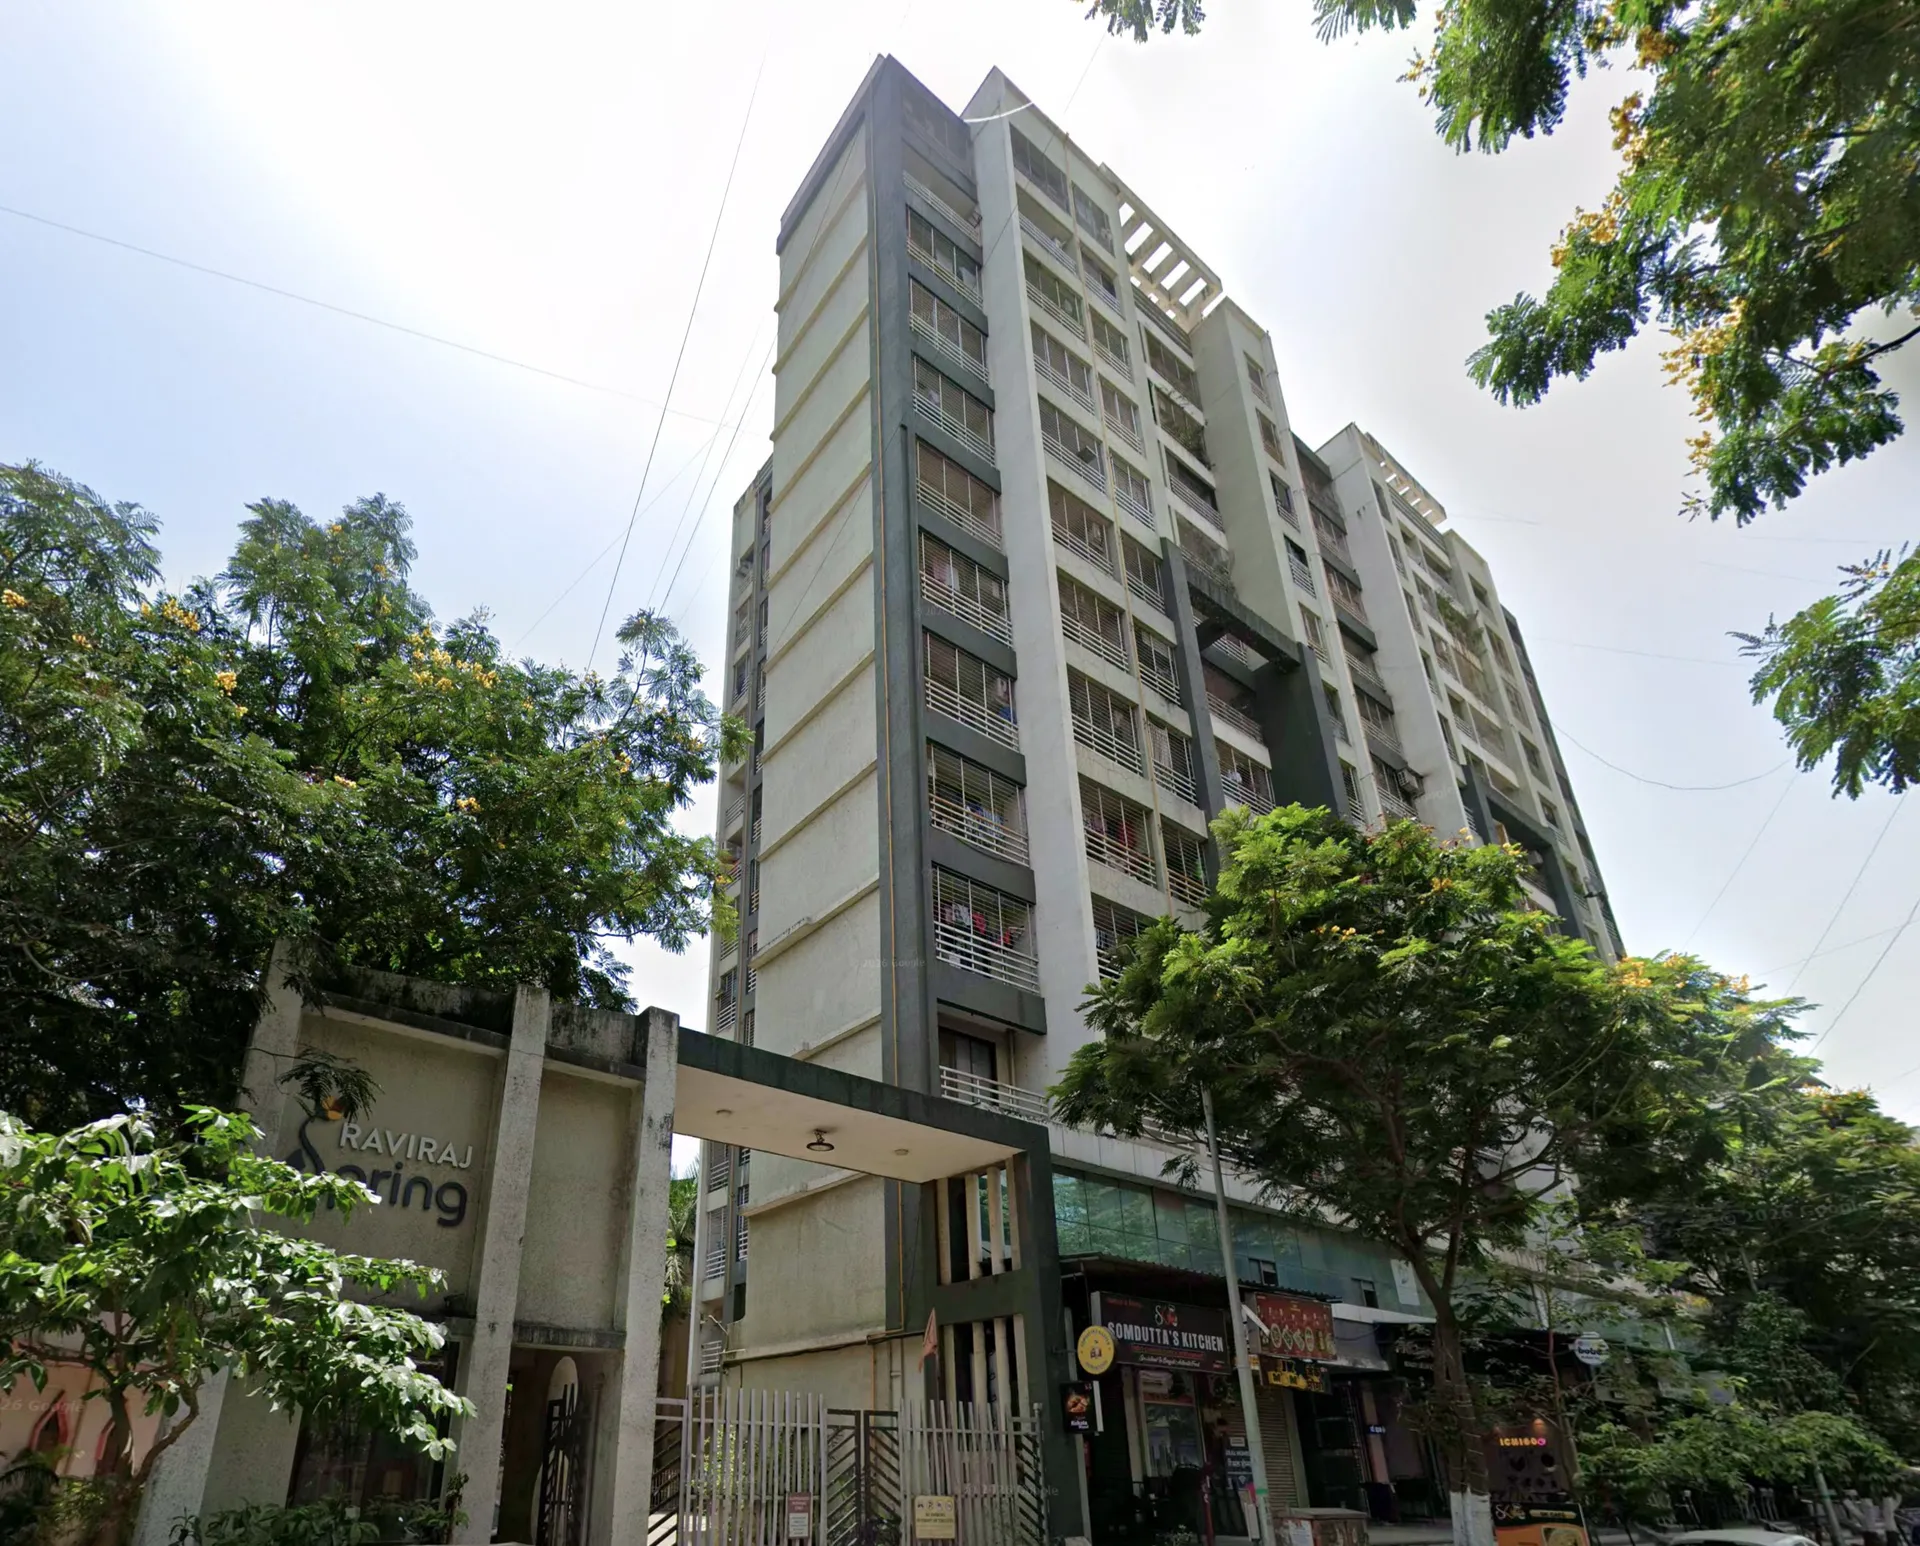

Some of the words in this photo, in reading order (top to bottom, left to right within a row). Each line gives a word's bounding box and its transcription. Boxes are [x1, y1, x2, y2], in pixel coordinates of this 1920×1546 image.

[339, 1121, 473, 1169] RAVIRAJ
[1107, 1321, 1179, 1346] SOMDUTTA'S
[1181, 1331, 1224, 1353] KITCHEN
